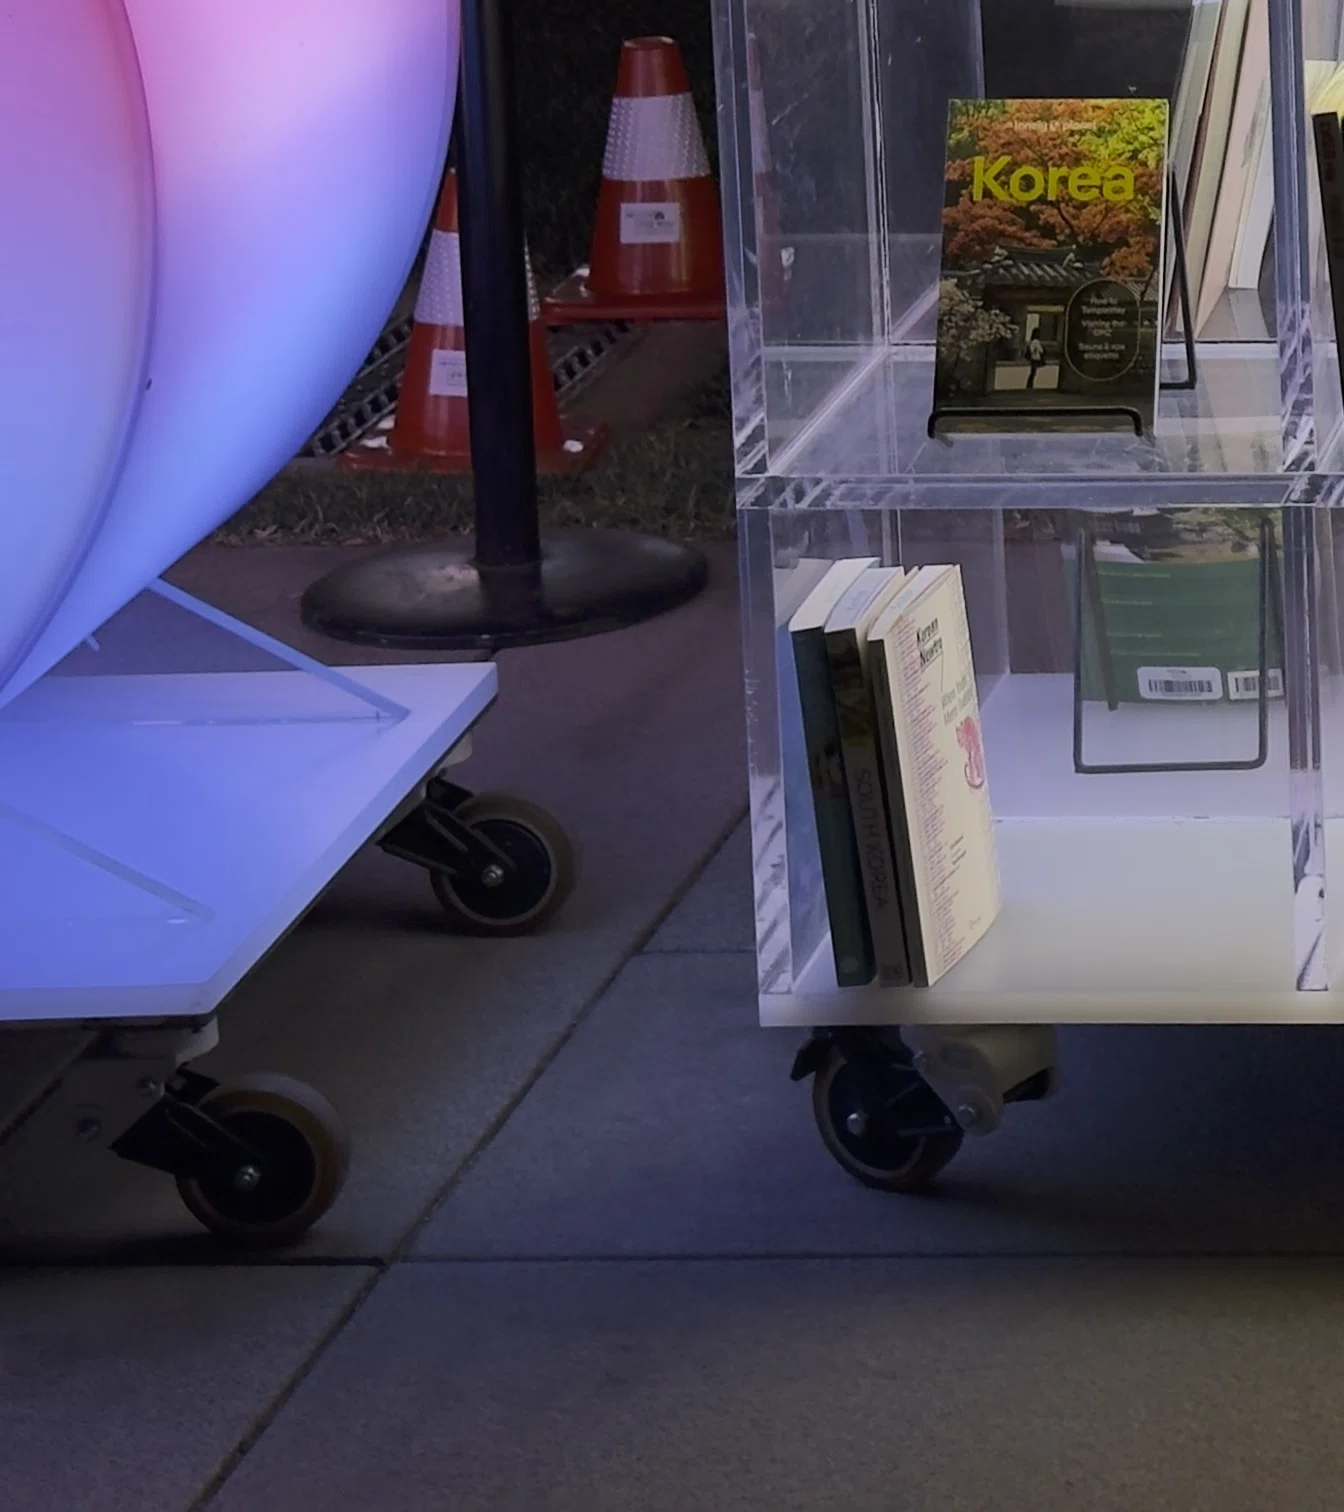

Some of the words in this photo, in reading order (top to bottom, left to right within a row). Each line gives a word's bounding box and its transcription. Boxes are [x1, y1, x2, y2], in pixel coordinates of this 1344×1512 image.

[973, 153, 1136, 203] Korea
[915, 617, 940, 648] Korean
[854, 767, 881, 845] SOUTH
[866, 841, 891, 911] KOREA
